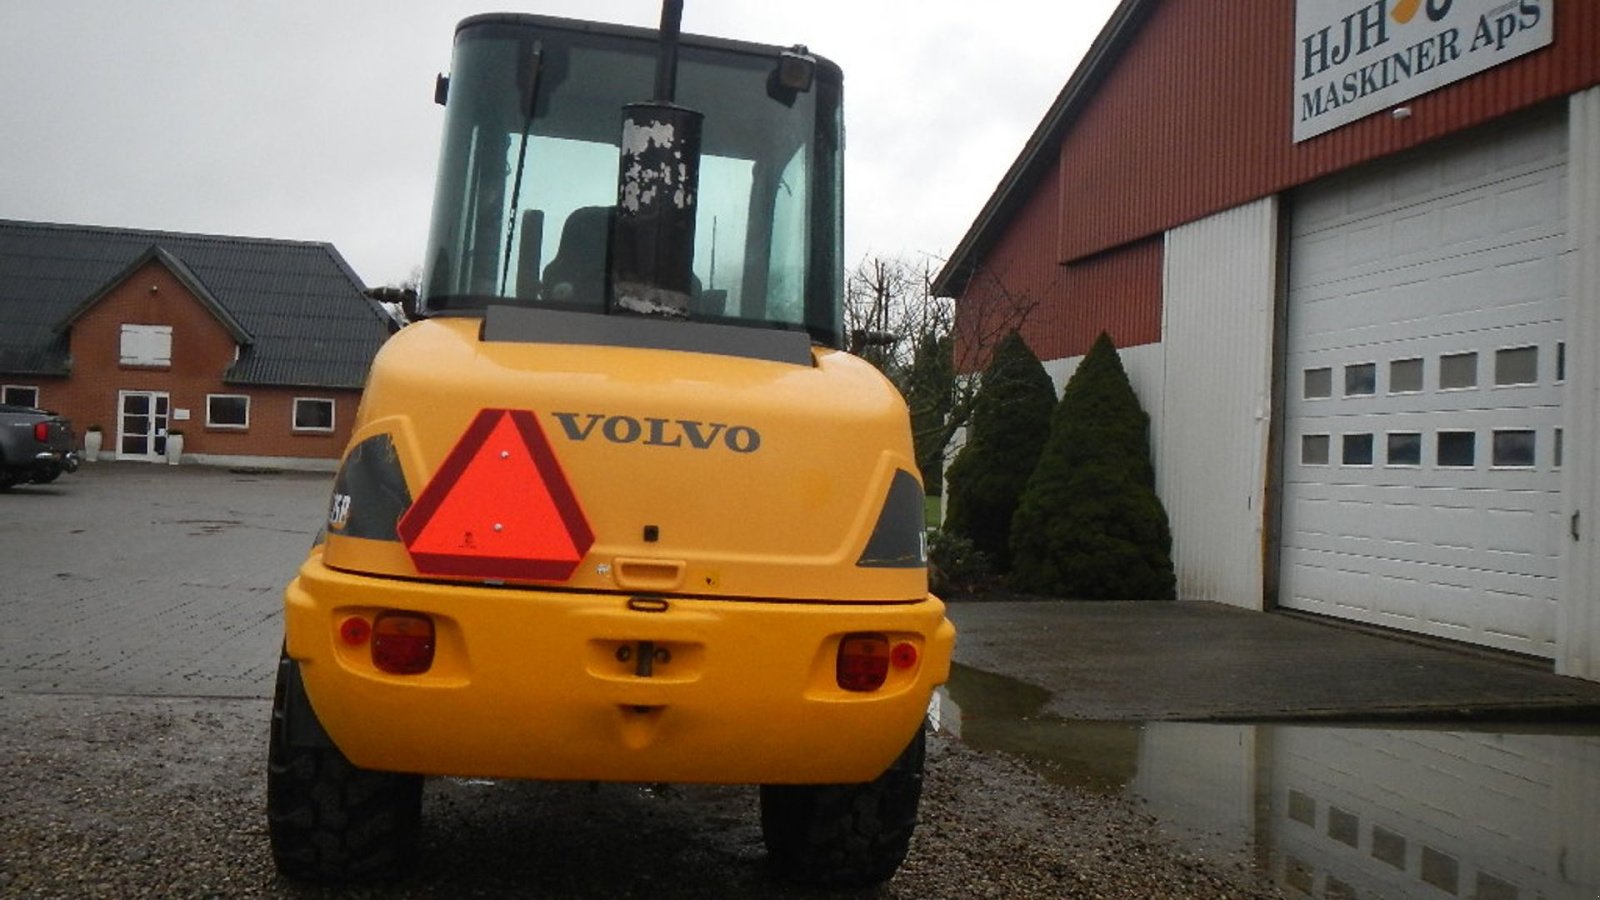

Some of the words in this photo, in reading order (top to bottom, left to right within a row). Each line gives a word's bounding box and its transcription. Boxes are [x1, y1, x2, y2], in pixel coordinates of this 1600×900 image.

[1301, 28, 1461, 121] MASKINER
[1469, 0, 1540, 52] ApS
[1302, 0, 1389, 80] HJH
[552, 412, 761, 453] VOLVO
